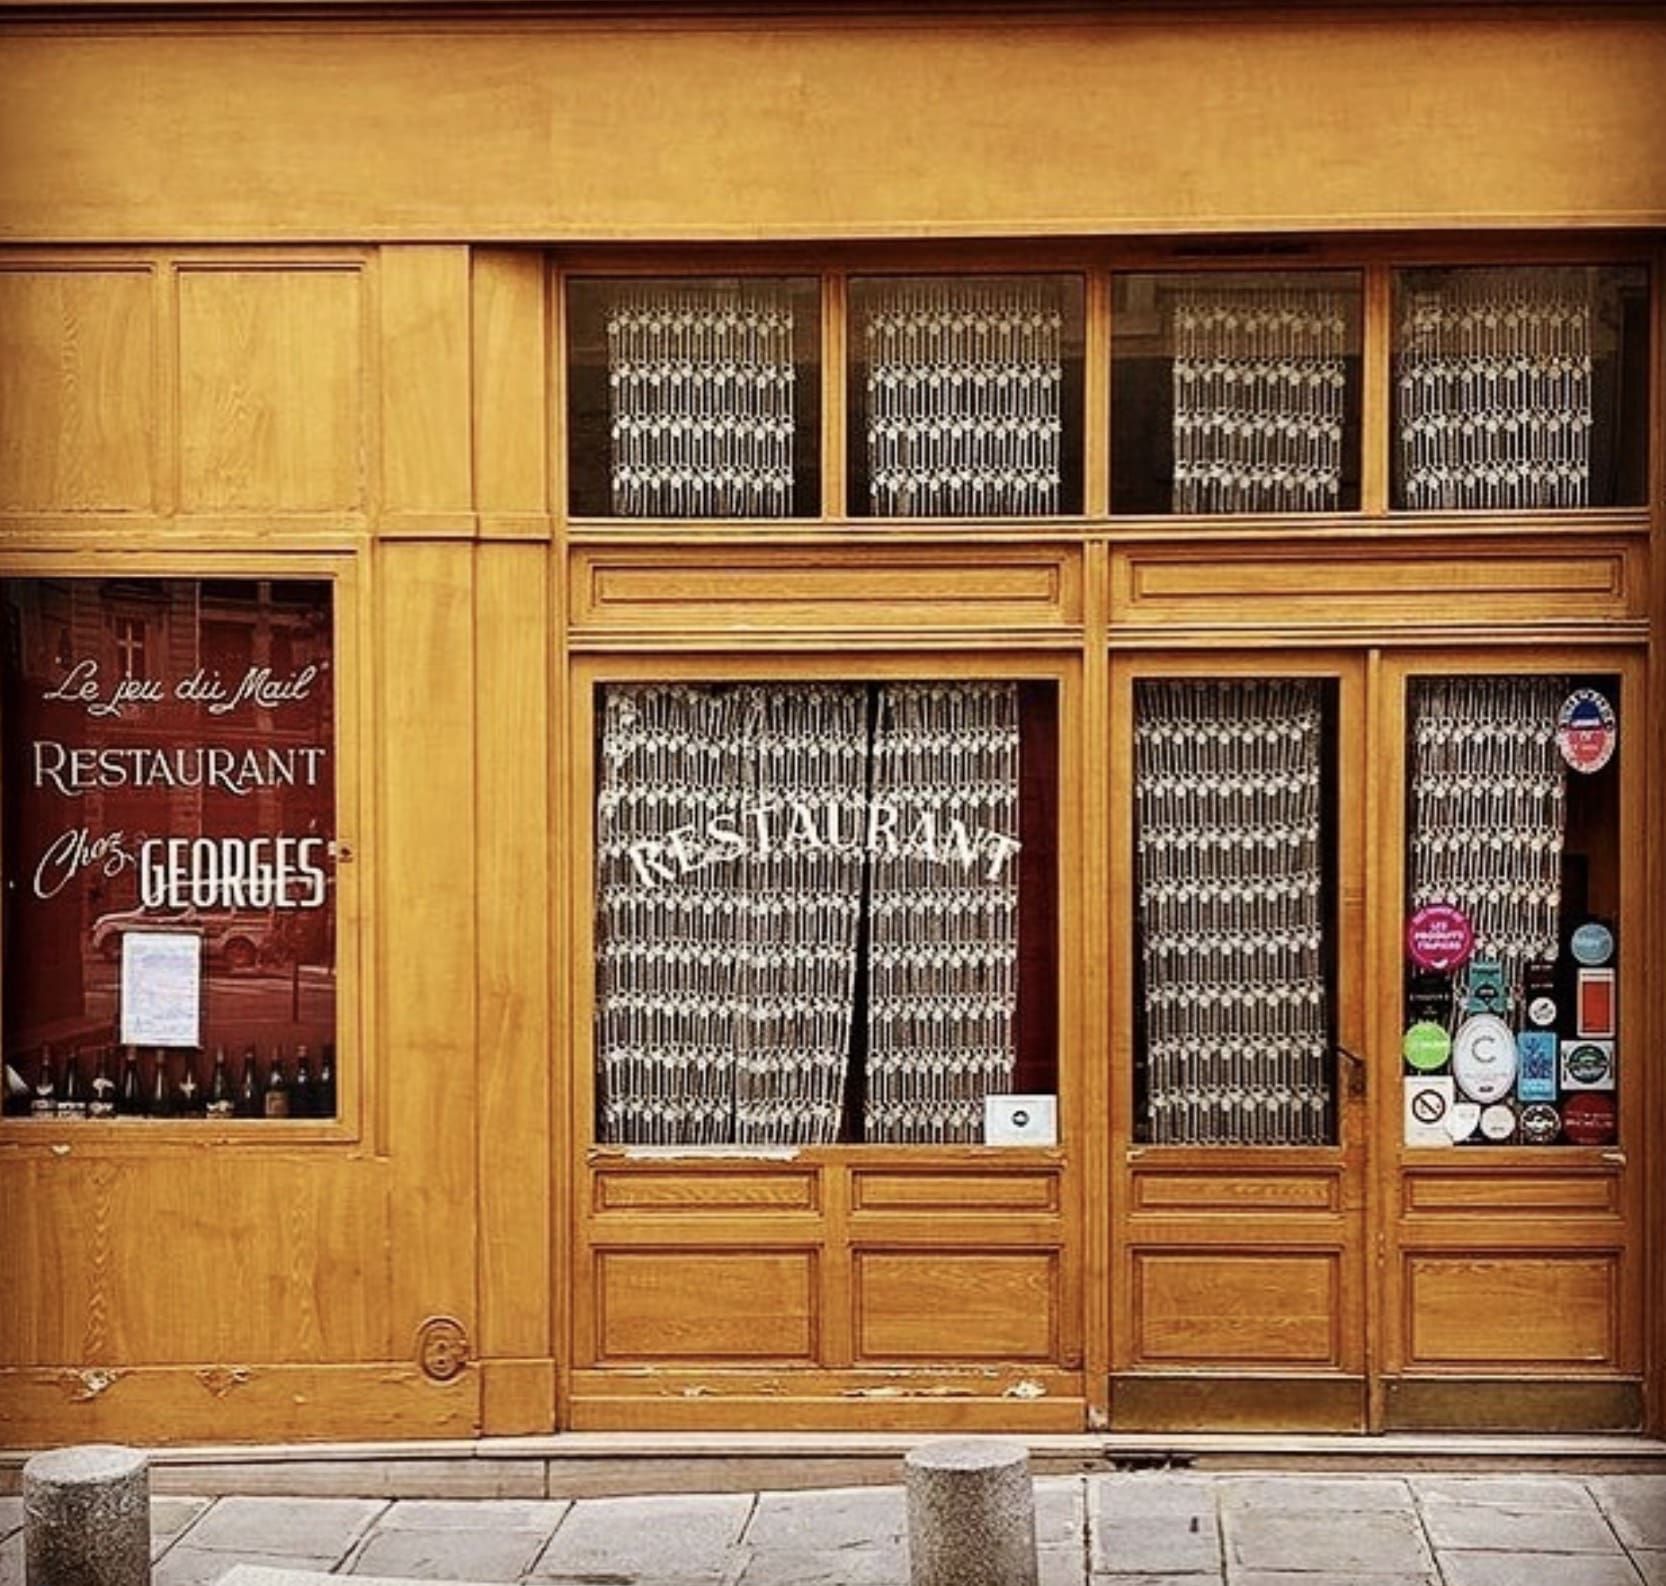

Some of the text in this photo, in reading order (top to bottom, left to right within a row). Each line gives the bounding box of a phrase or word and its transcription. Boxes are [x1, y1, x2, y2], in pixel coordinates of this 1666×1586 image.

[88, 670, 165, 717] jeu
[174, 668, 227, 700] du
[33, 740, 326, 796] RESTAURANT
[141, 837, 325, 908] GEORGES
[627, 799, 1022, 888] RESTAURANT
